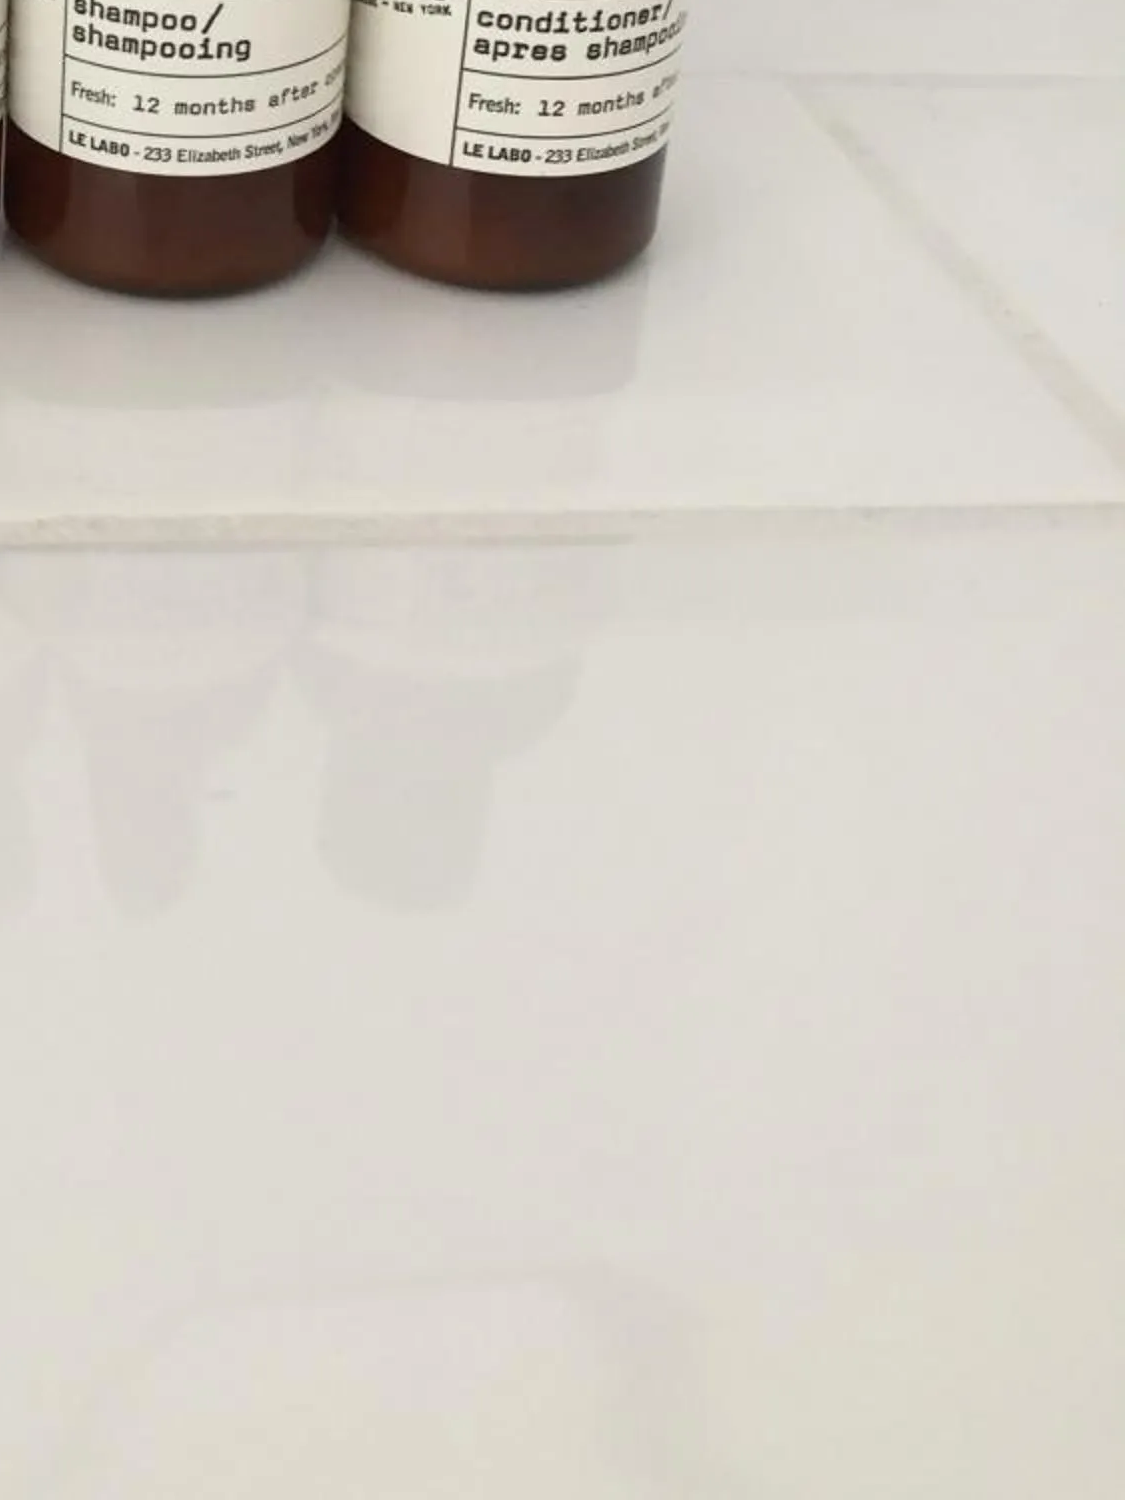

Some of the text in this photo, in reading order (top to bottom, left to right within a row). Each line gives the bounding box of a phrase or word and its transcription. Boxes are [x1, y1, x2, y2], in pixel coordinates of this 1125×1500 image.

[72, 22, 252, 61] shampooing
[473, 37, 567, 62] apres
[71, 80, 318, 116] Fresh: 12 months after
[468, 92, 521, 115] Fresh:
[537, 100, 565, 117] 12
[577, 91, 644, 116] months
[69, 130, 86, 146] LE
[90, 136, 129, 157] LABO
[143, 148, 172, 162] 233
[177, 148, 242, 163] Elizabeth
[245, 137, 283, 159] Street,
[286, 126, 313, 149] New
[463, 142, 484, 157] LE
[488, 145, 531, 163] LABO
[544, 149, 573, 164] 233
[576, 142, 630, 162] Elizabeth
